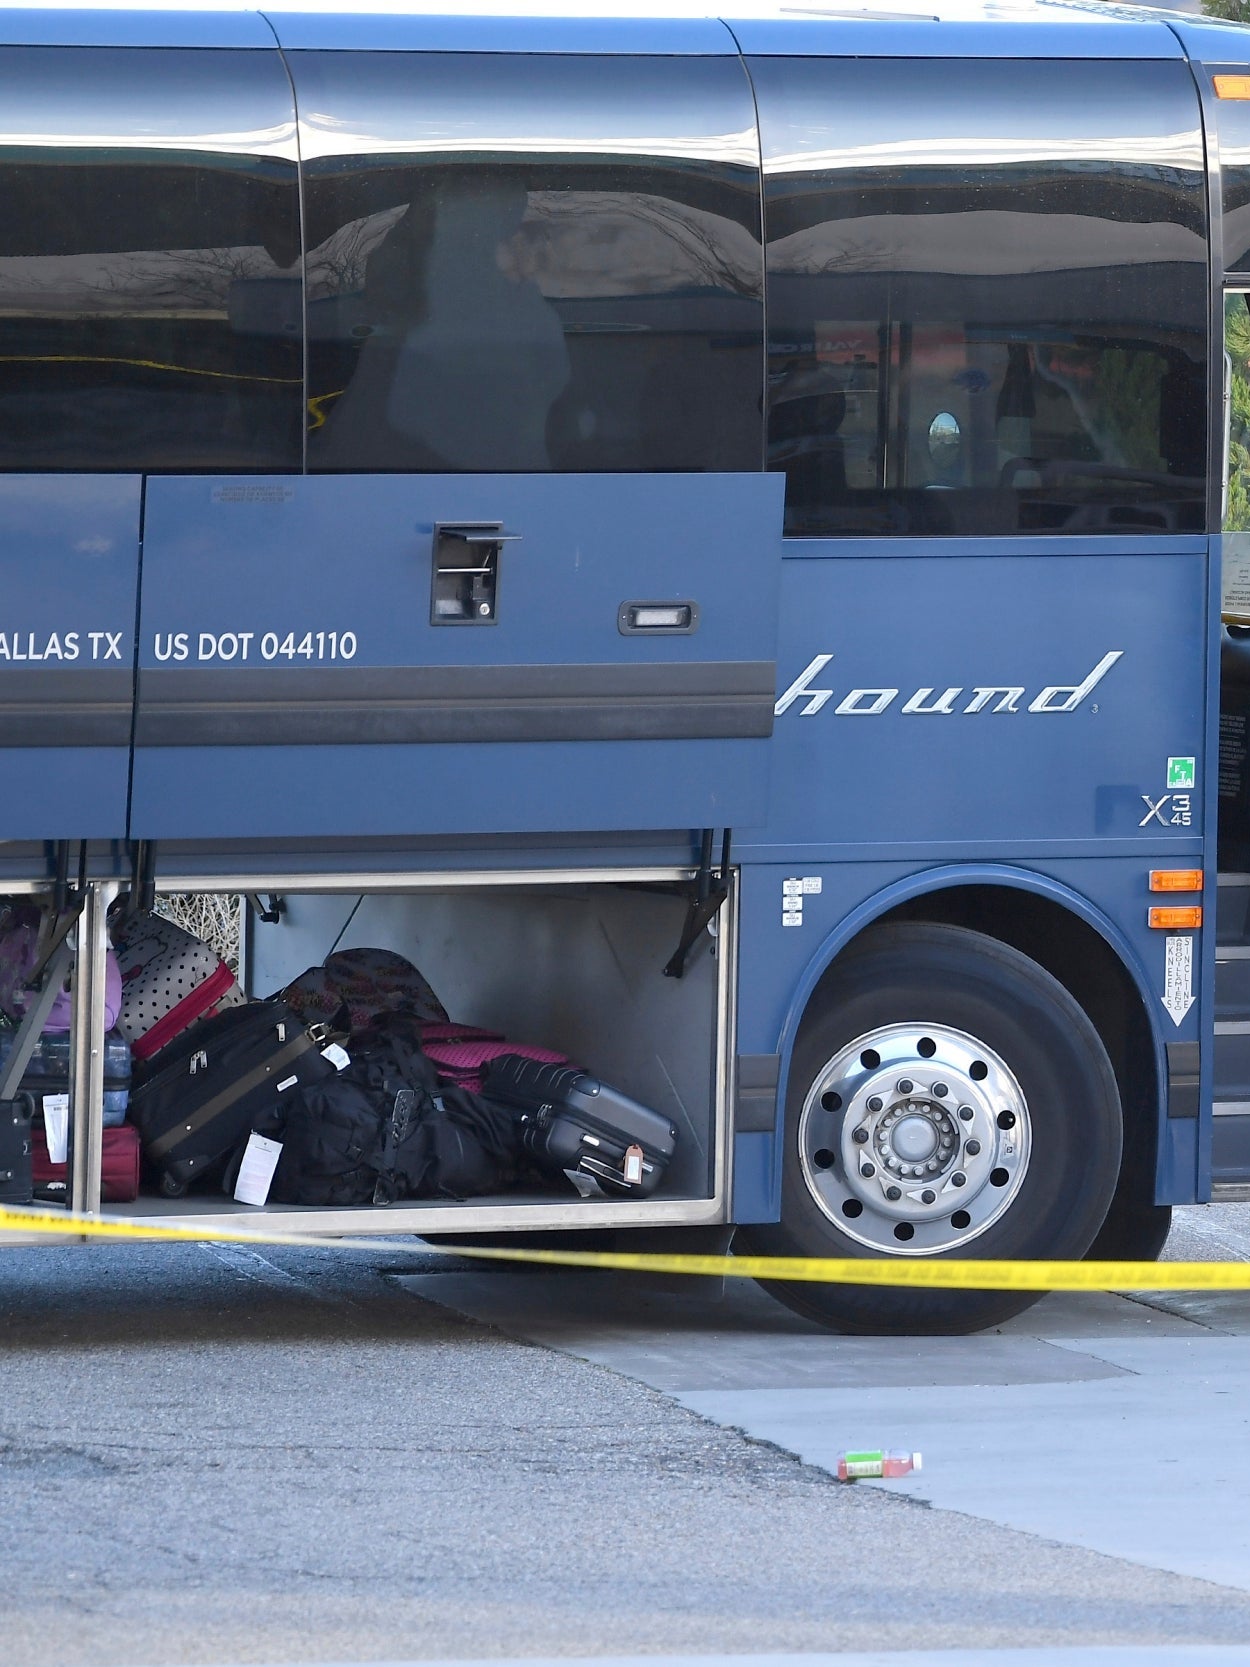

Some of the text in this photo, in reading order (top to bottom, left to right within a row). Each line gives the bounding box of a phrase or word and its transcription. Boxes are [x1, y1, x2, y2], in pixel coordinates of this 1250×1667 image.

[88, 631, 123, 660] TX
[154, 631, 357, 661] US DOT 044110
[1171, 811, 1192, 826] 45
